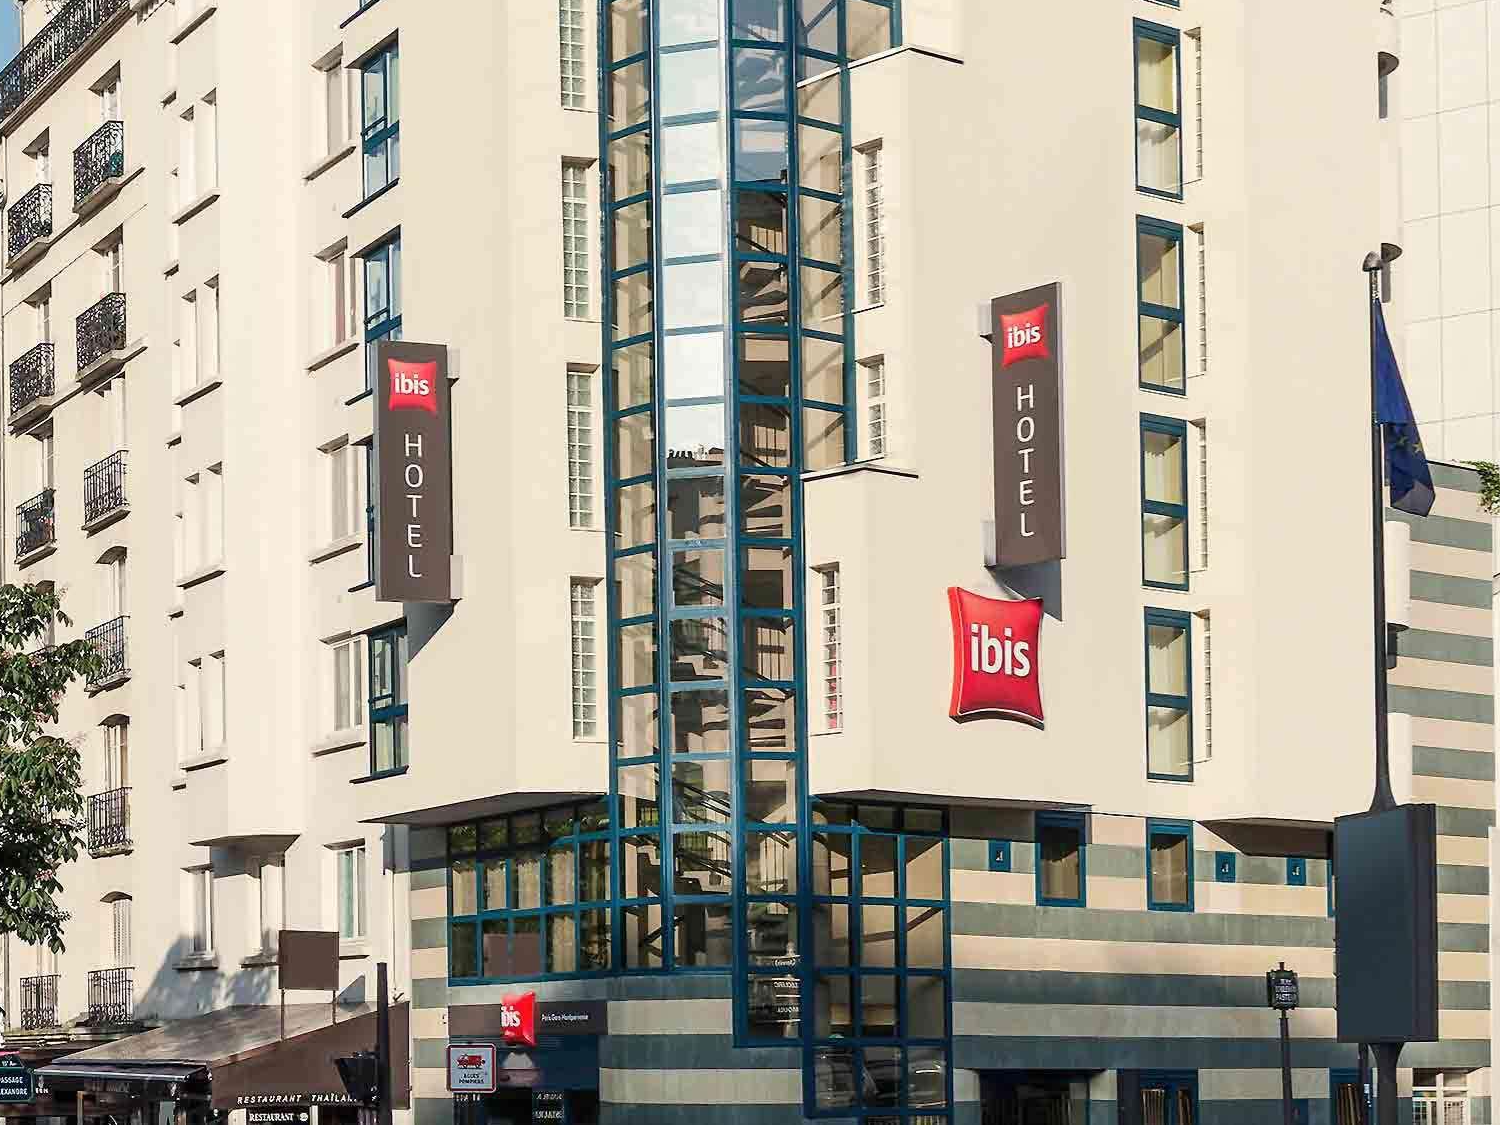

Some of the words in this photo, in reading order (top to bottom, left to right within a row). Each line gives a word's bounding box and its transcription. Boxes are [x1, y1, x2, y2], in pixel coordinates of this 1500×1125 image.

[1007, 322, 1041, 349] ibis
[394, 372, 430, 396] ibis
[1016, 385, 1035, 537] HOTEL
[404, 433, 424, 579] HOTEL
[971, 623, 1030, 677] ibis
[237, 1094, 302, 1104] RESTAURANT
[249, 1112, 294, 1122] RESTAURANT
